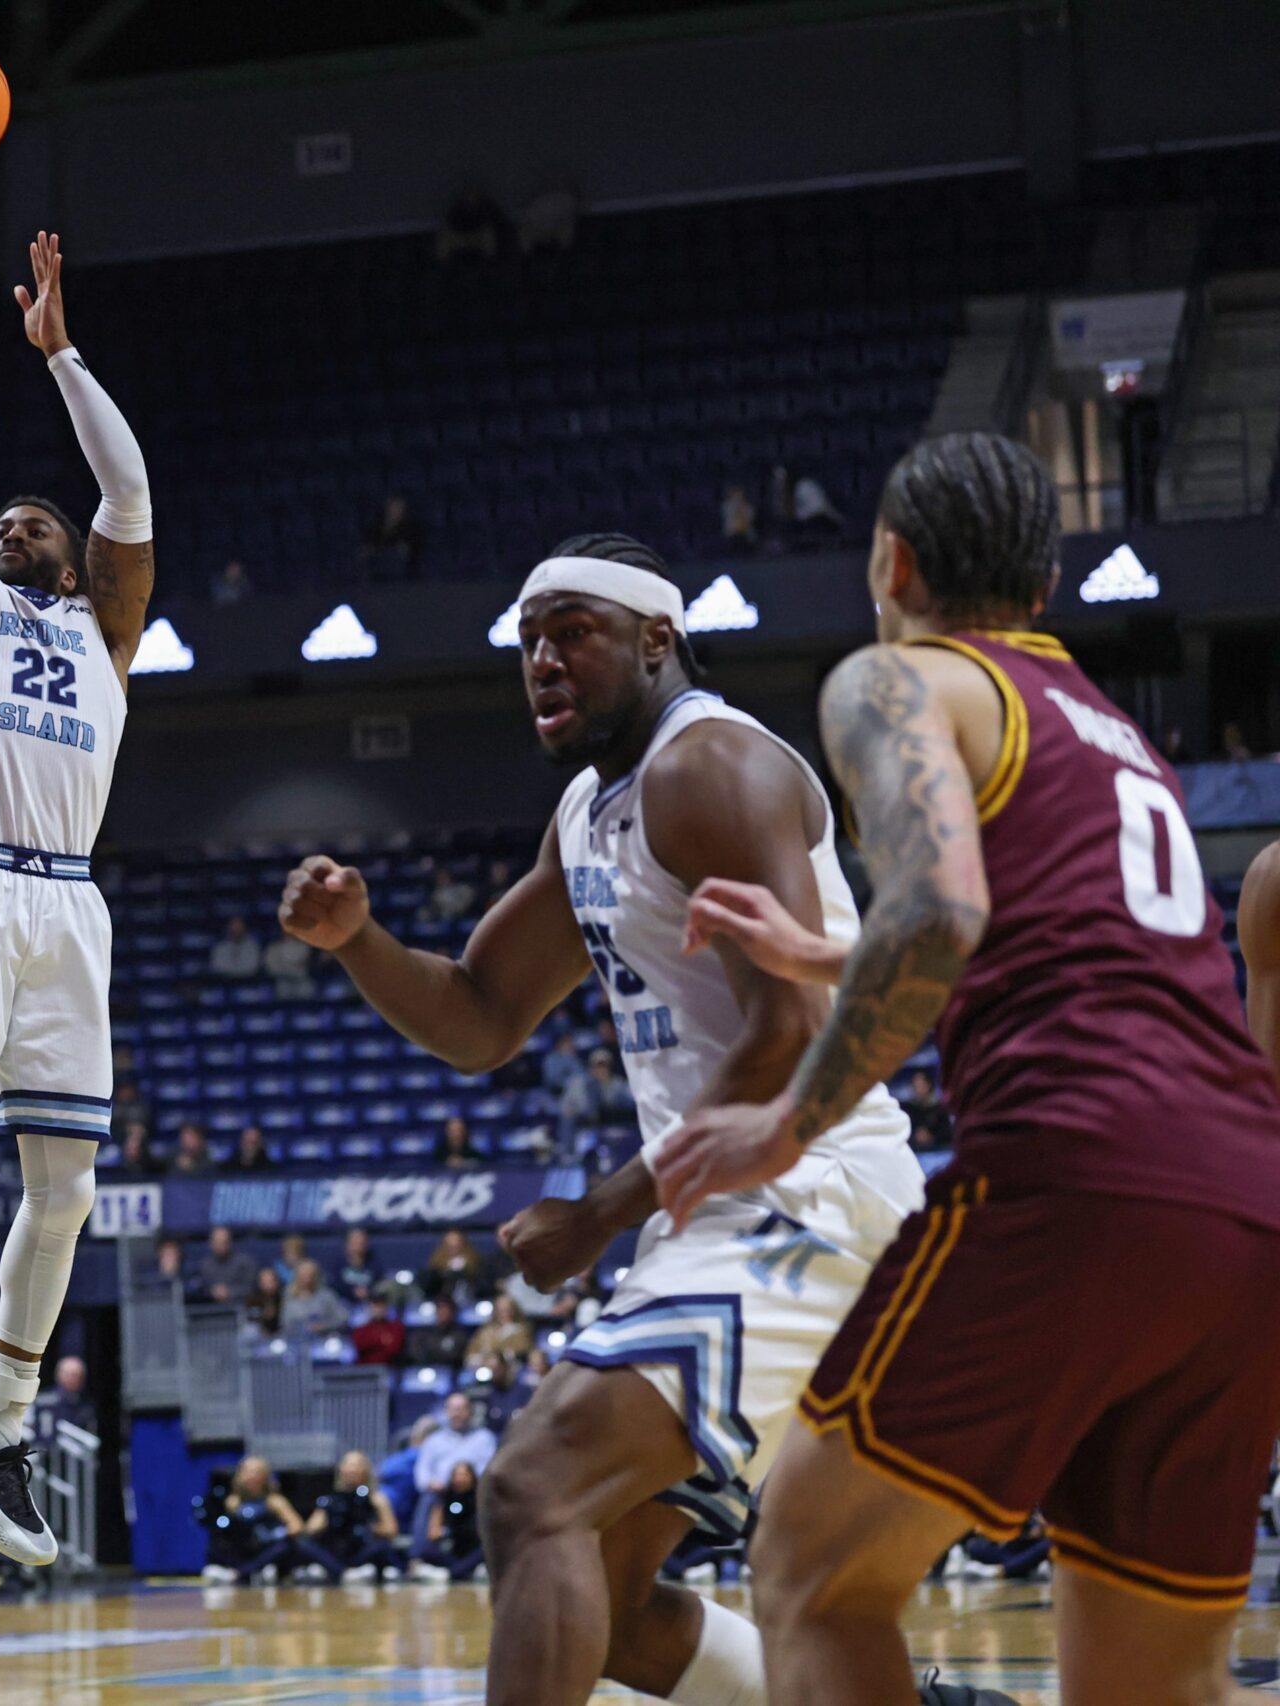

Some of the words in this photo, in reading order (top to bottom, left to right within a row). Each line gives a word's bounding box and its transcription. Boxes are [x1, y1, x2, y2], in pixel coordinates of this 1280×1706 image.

[11, 647, 78, 709] 22
[1114, 768, 1207, 938] 0
[100, 1193, 150, 1231] 114
